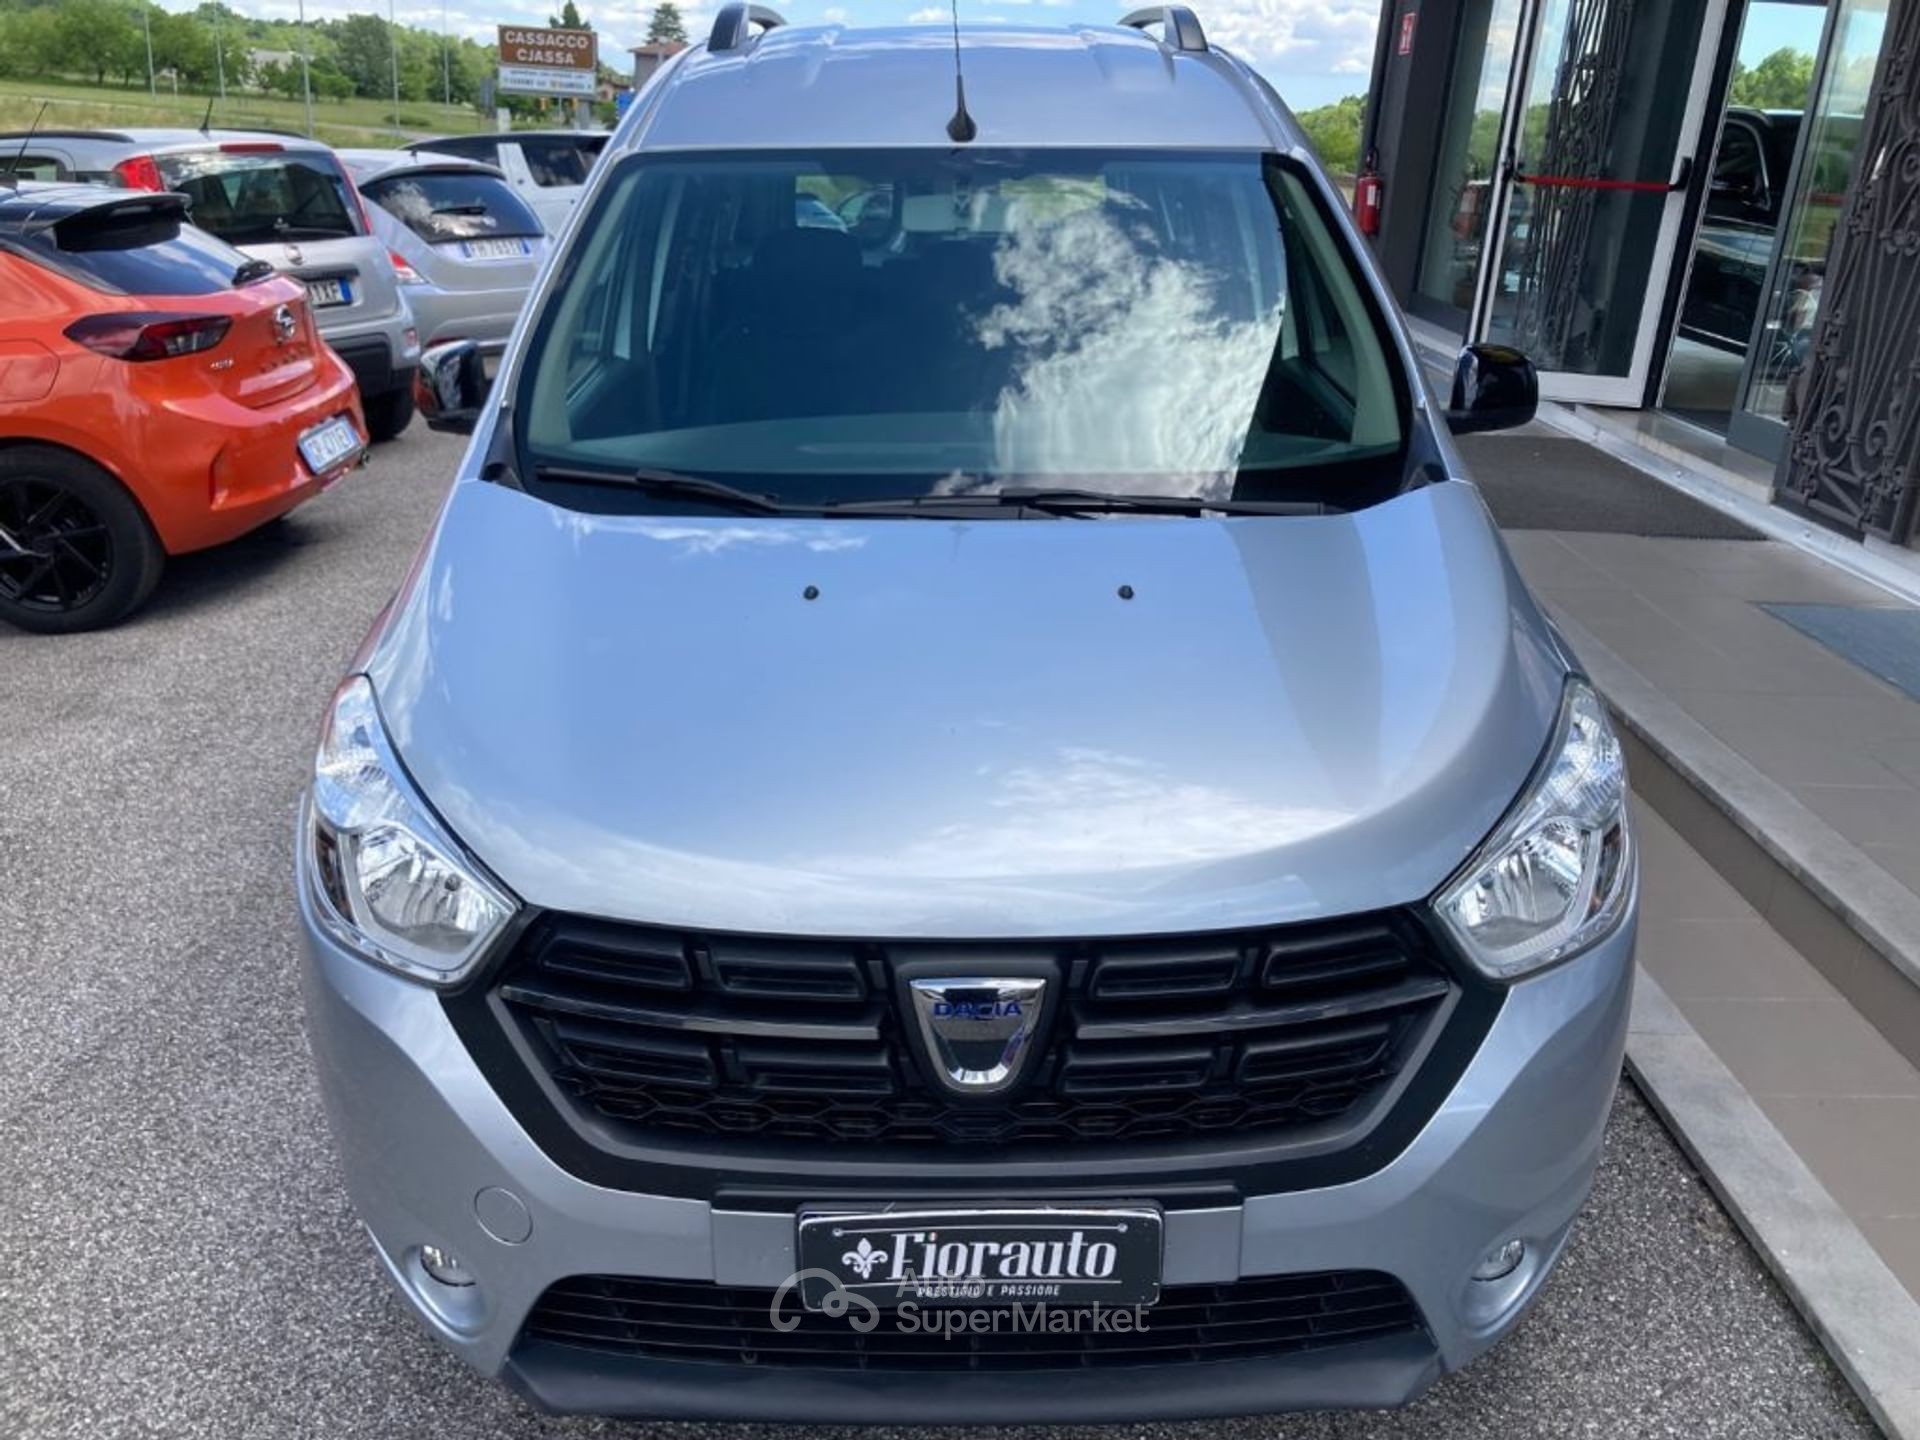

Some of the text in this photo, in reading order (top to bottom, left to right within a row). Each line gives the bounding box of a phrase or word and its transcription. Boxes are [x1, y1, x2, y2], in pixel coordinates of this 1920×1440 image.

[504, 30, 589, 49] CASSACCO
[516, 48, 576, 65] CJASSA
[933, 1001, 1023, 1018] DACIA
[886, 1231, 1118, 1280] Fiorauto
[987, 1285, 995, 1297] E
[1001, 1284, 1062, 1297] PASSIONE
